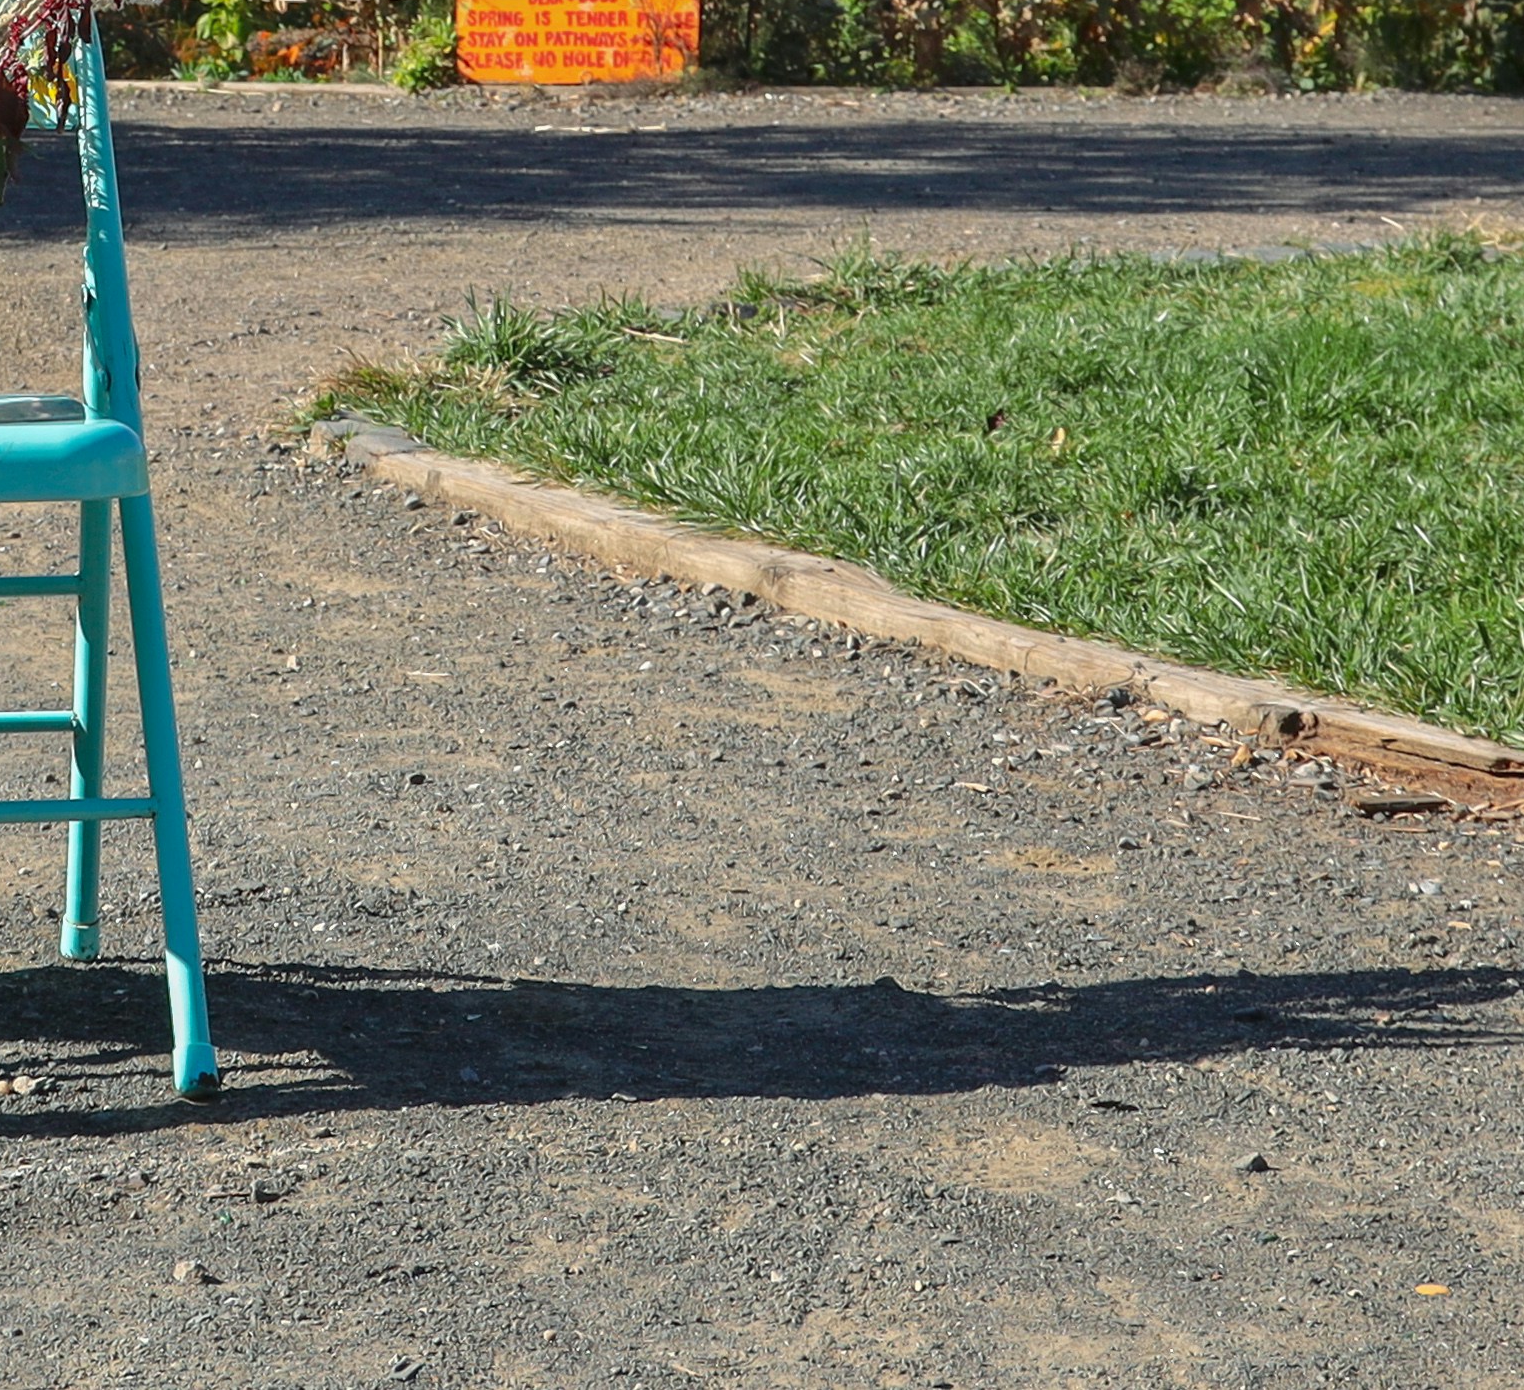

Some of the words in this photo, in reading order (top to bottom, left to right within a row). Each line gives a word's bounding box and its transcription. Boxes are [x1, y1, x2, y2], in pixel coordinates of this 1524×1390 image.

[467, 10, 524, 27] SPRING
[535, 10, 552, 27] IS
[565, 10, 629, 27] TENDER
[467, 31, 506, 48] STAY
[514, 31, 539, 47] ON
[545, 31, 627, 48] PATHWAYS
[464, 51, 525, 70] PLEASE
[533, 50, 557, 69] NO
[563, 50, 606, 69] HOLE
[613, 50, 672, 69] DIGN
